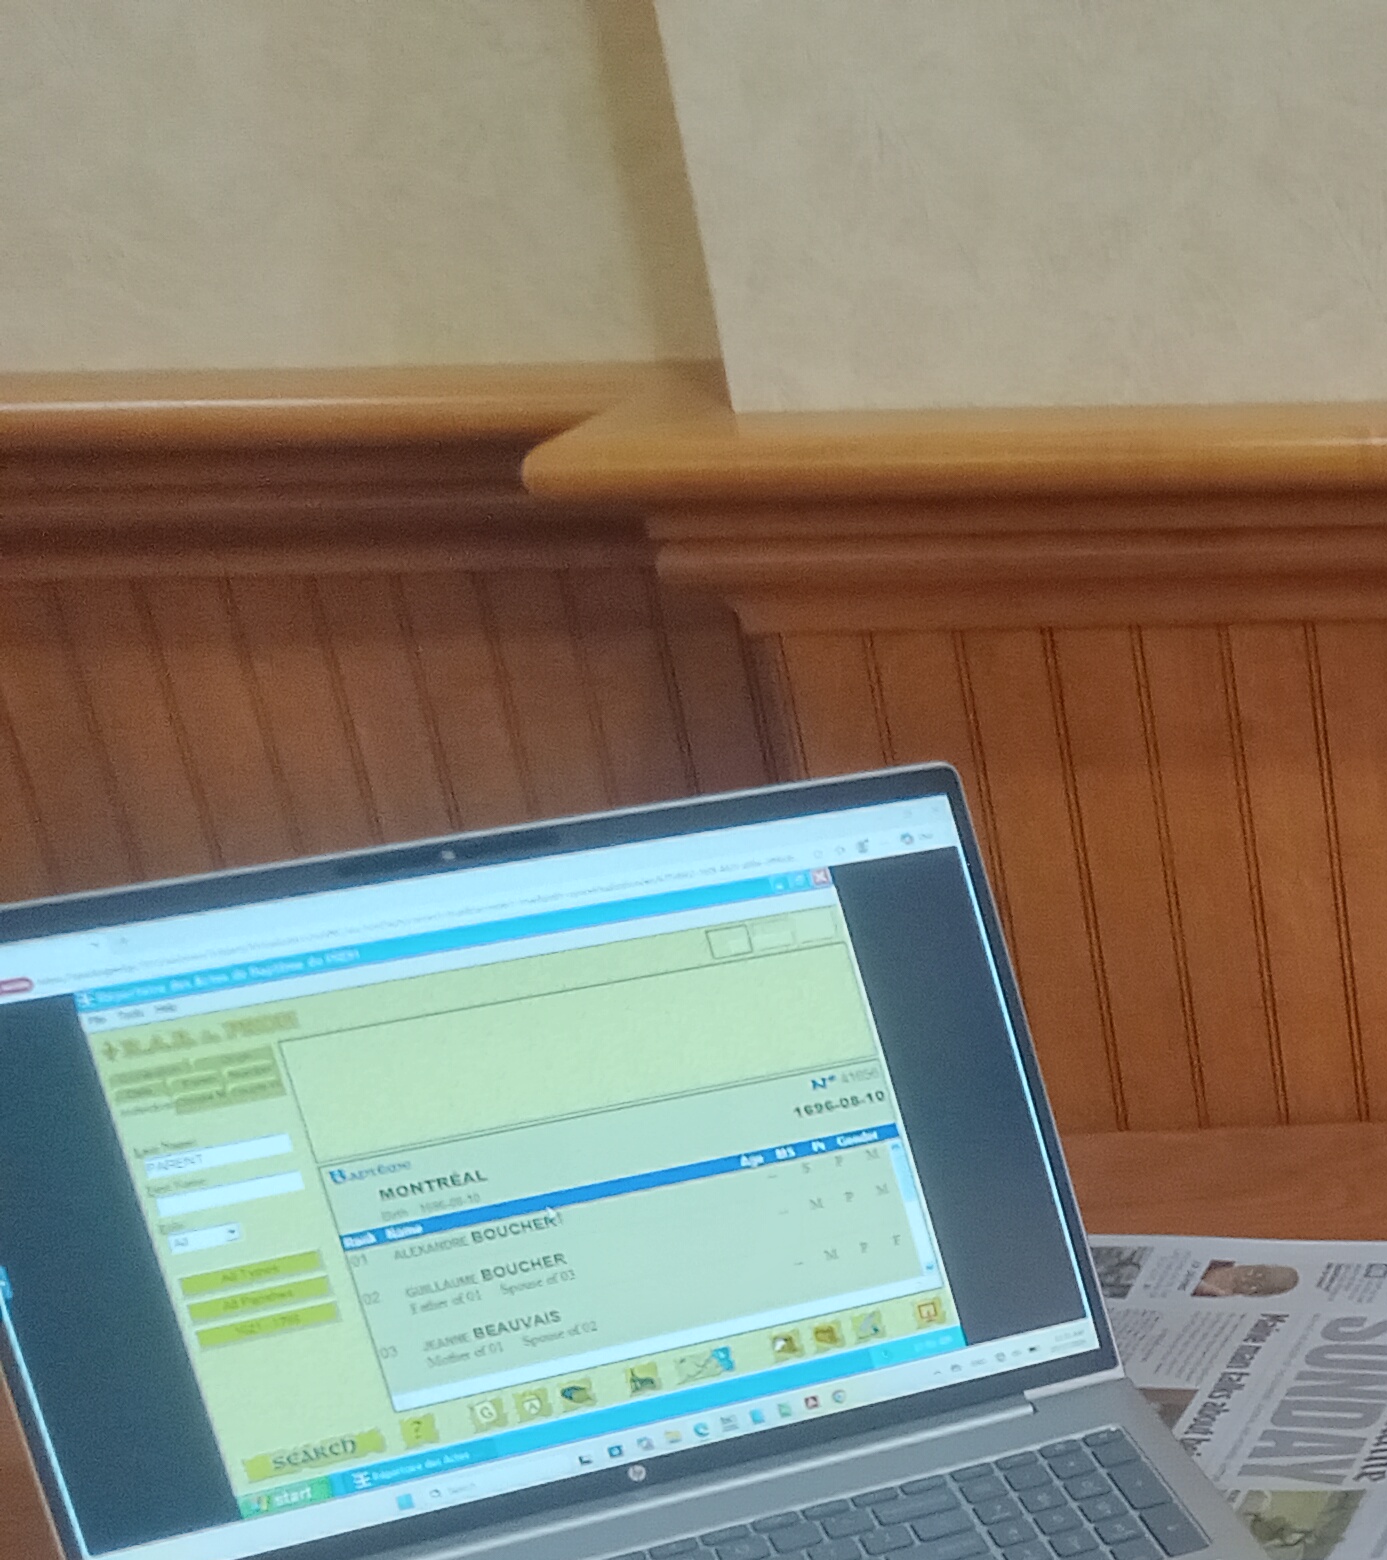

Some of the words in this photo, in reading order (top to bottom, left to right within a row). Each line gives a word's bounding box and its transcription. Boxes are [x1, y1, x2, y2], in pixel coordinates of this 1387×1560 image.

[377, 1168, 490, 1203] MONTRÉAL
[393, 1234, 470, 1262] ALEXANDRE
[480, 1251, 569, 1282] BOUCHER
[472, 1309, 563, 1341] BEAUVAIS
[270, 1437, 358, 1472] SEARCH
[273, 1484, 314, 1507] start
